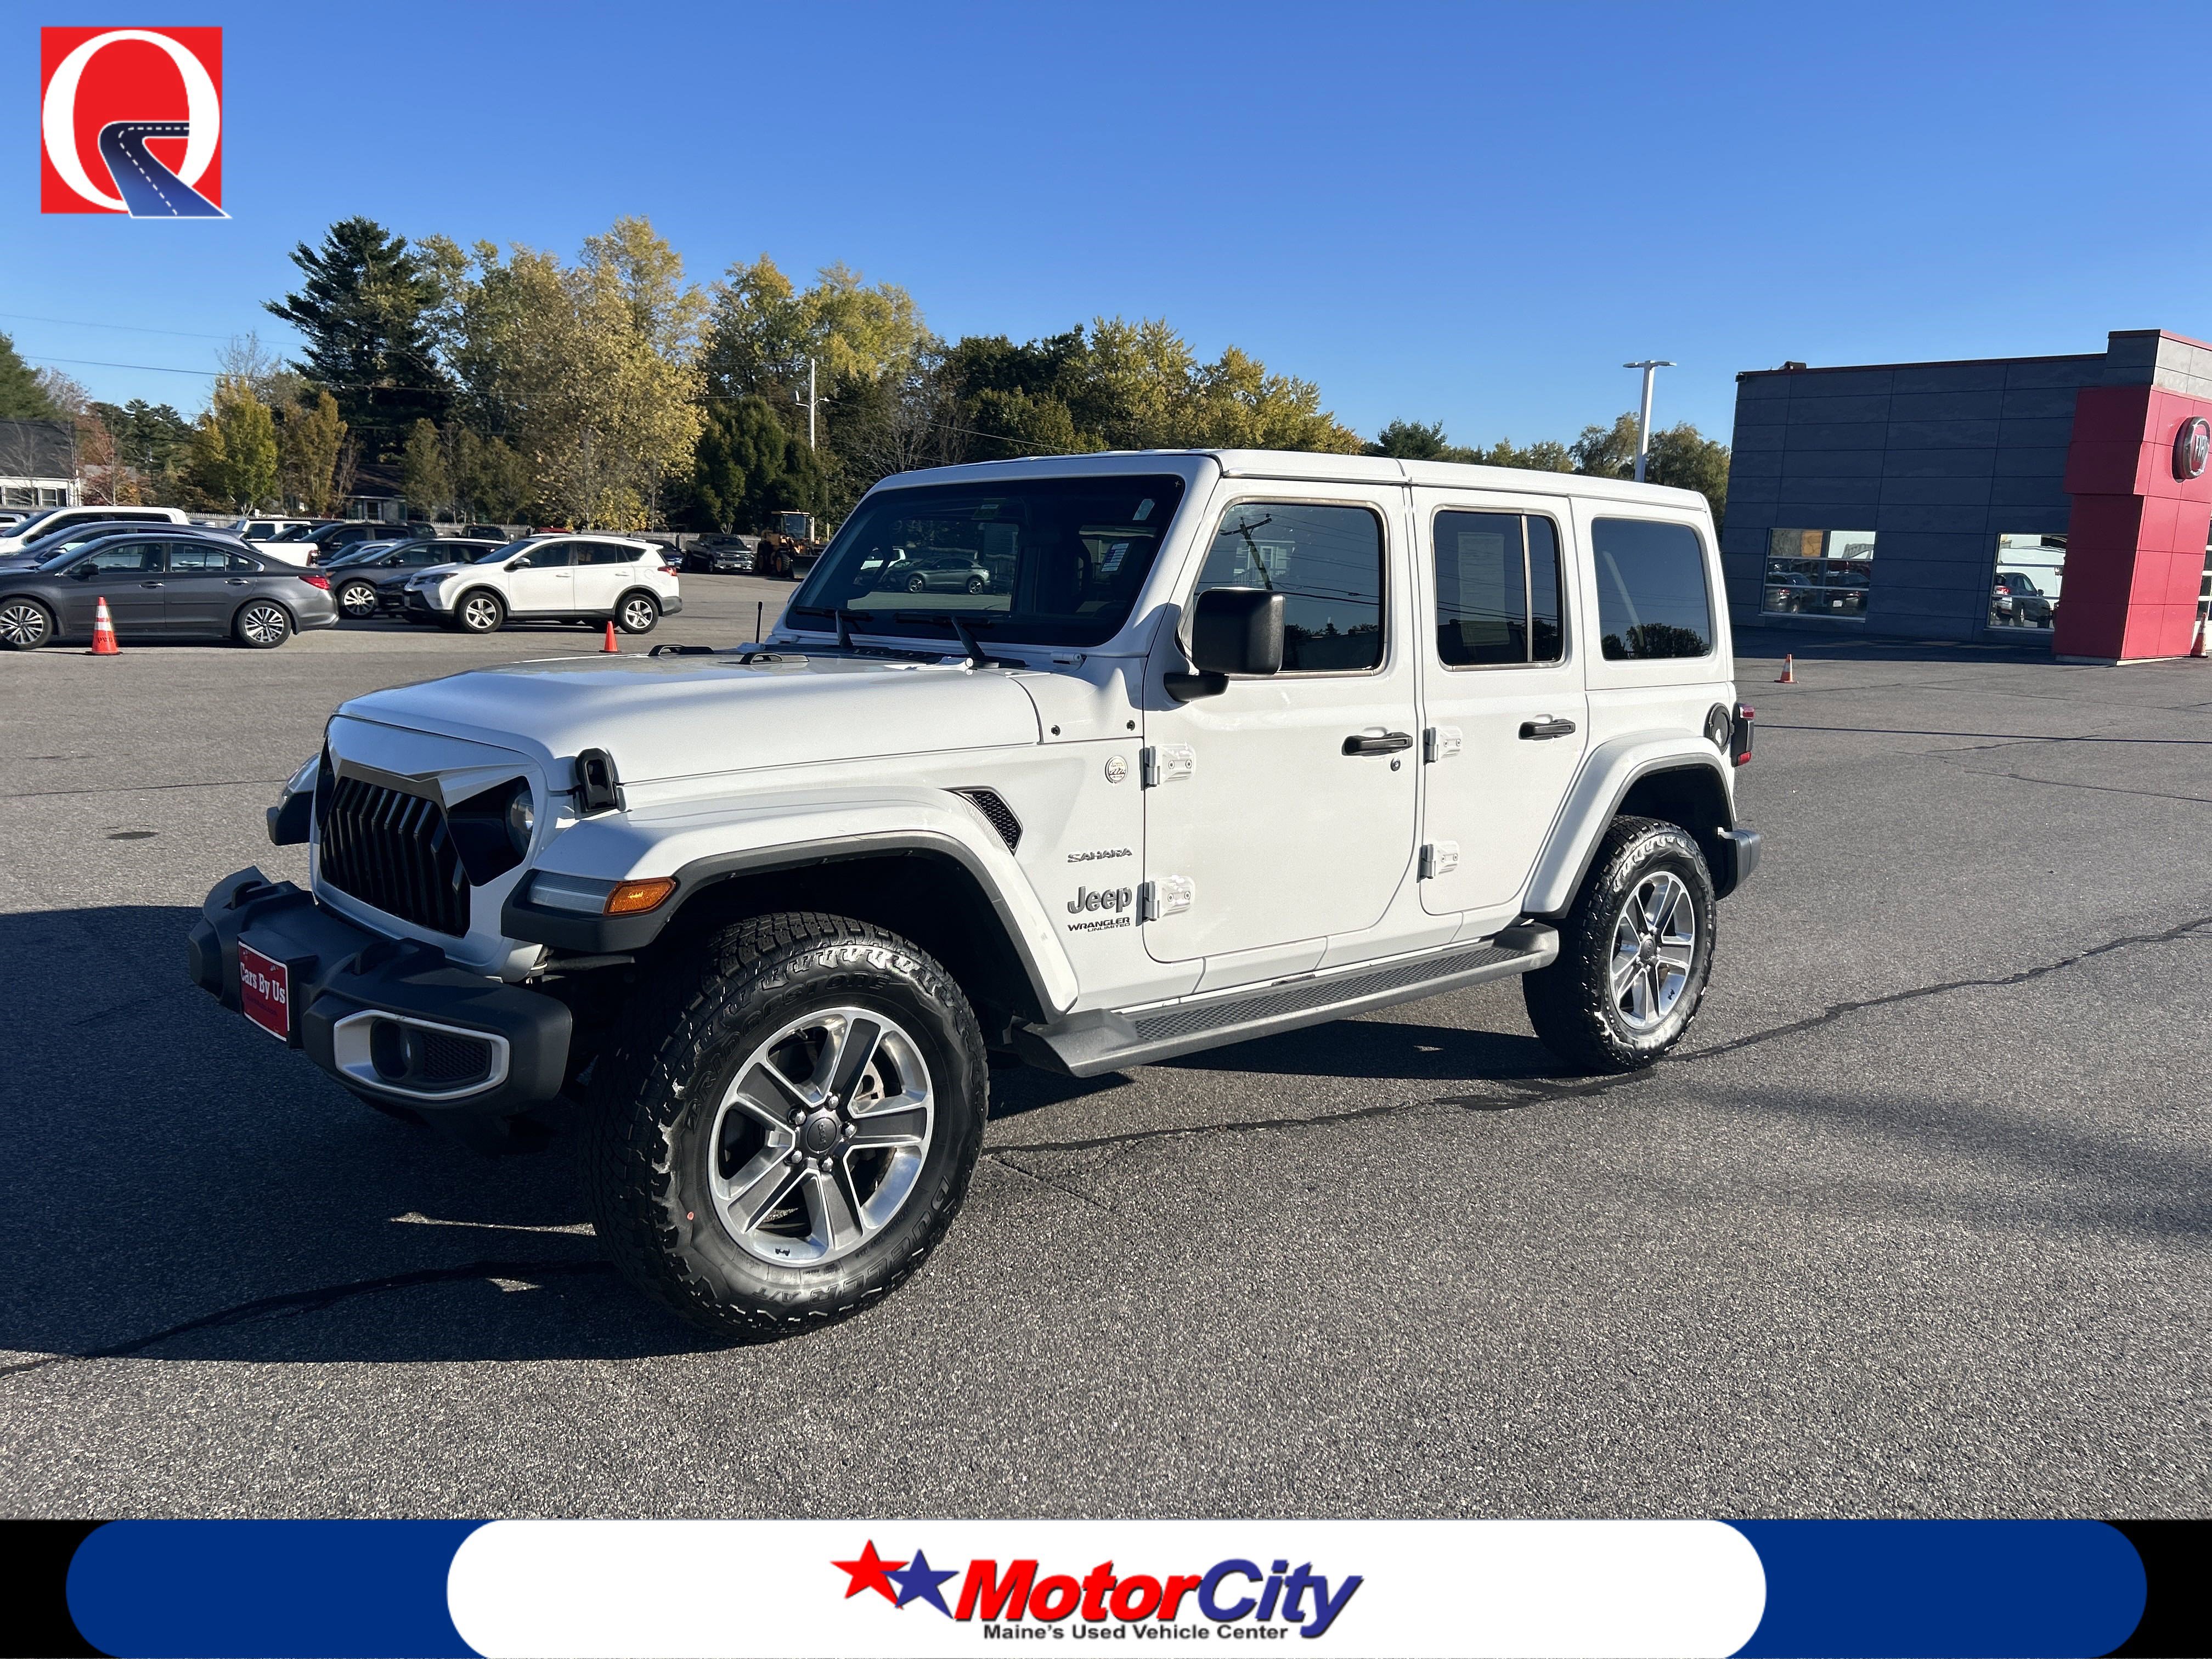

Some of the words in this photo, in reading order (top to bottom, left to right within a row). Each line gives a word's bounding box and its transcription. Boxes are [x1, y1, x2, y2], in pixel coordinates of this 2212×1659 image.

[1067, 848, 1132, 863] SAHARA
[1068, 885, 1132, 914] Jeep
[1068, 917, 1130, 932] WRANGLER
[1087, 922, 1131, 932] UNLIMITED
[240, 962, 257, 989] Cars
[258, 973, 270, 1000] By
[272, 980, 285, 1004] Us
[684, 970, 893, 1135] BRIDGESTONE
[808, 1175, 951, 1306] DUELER
[751, 1286, 802, 1303] A/T
